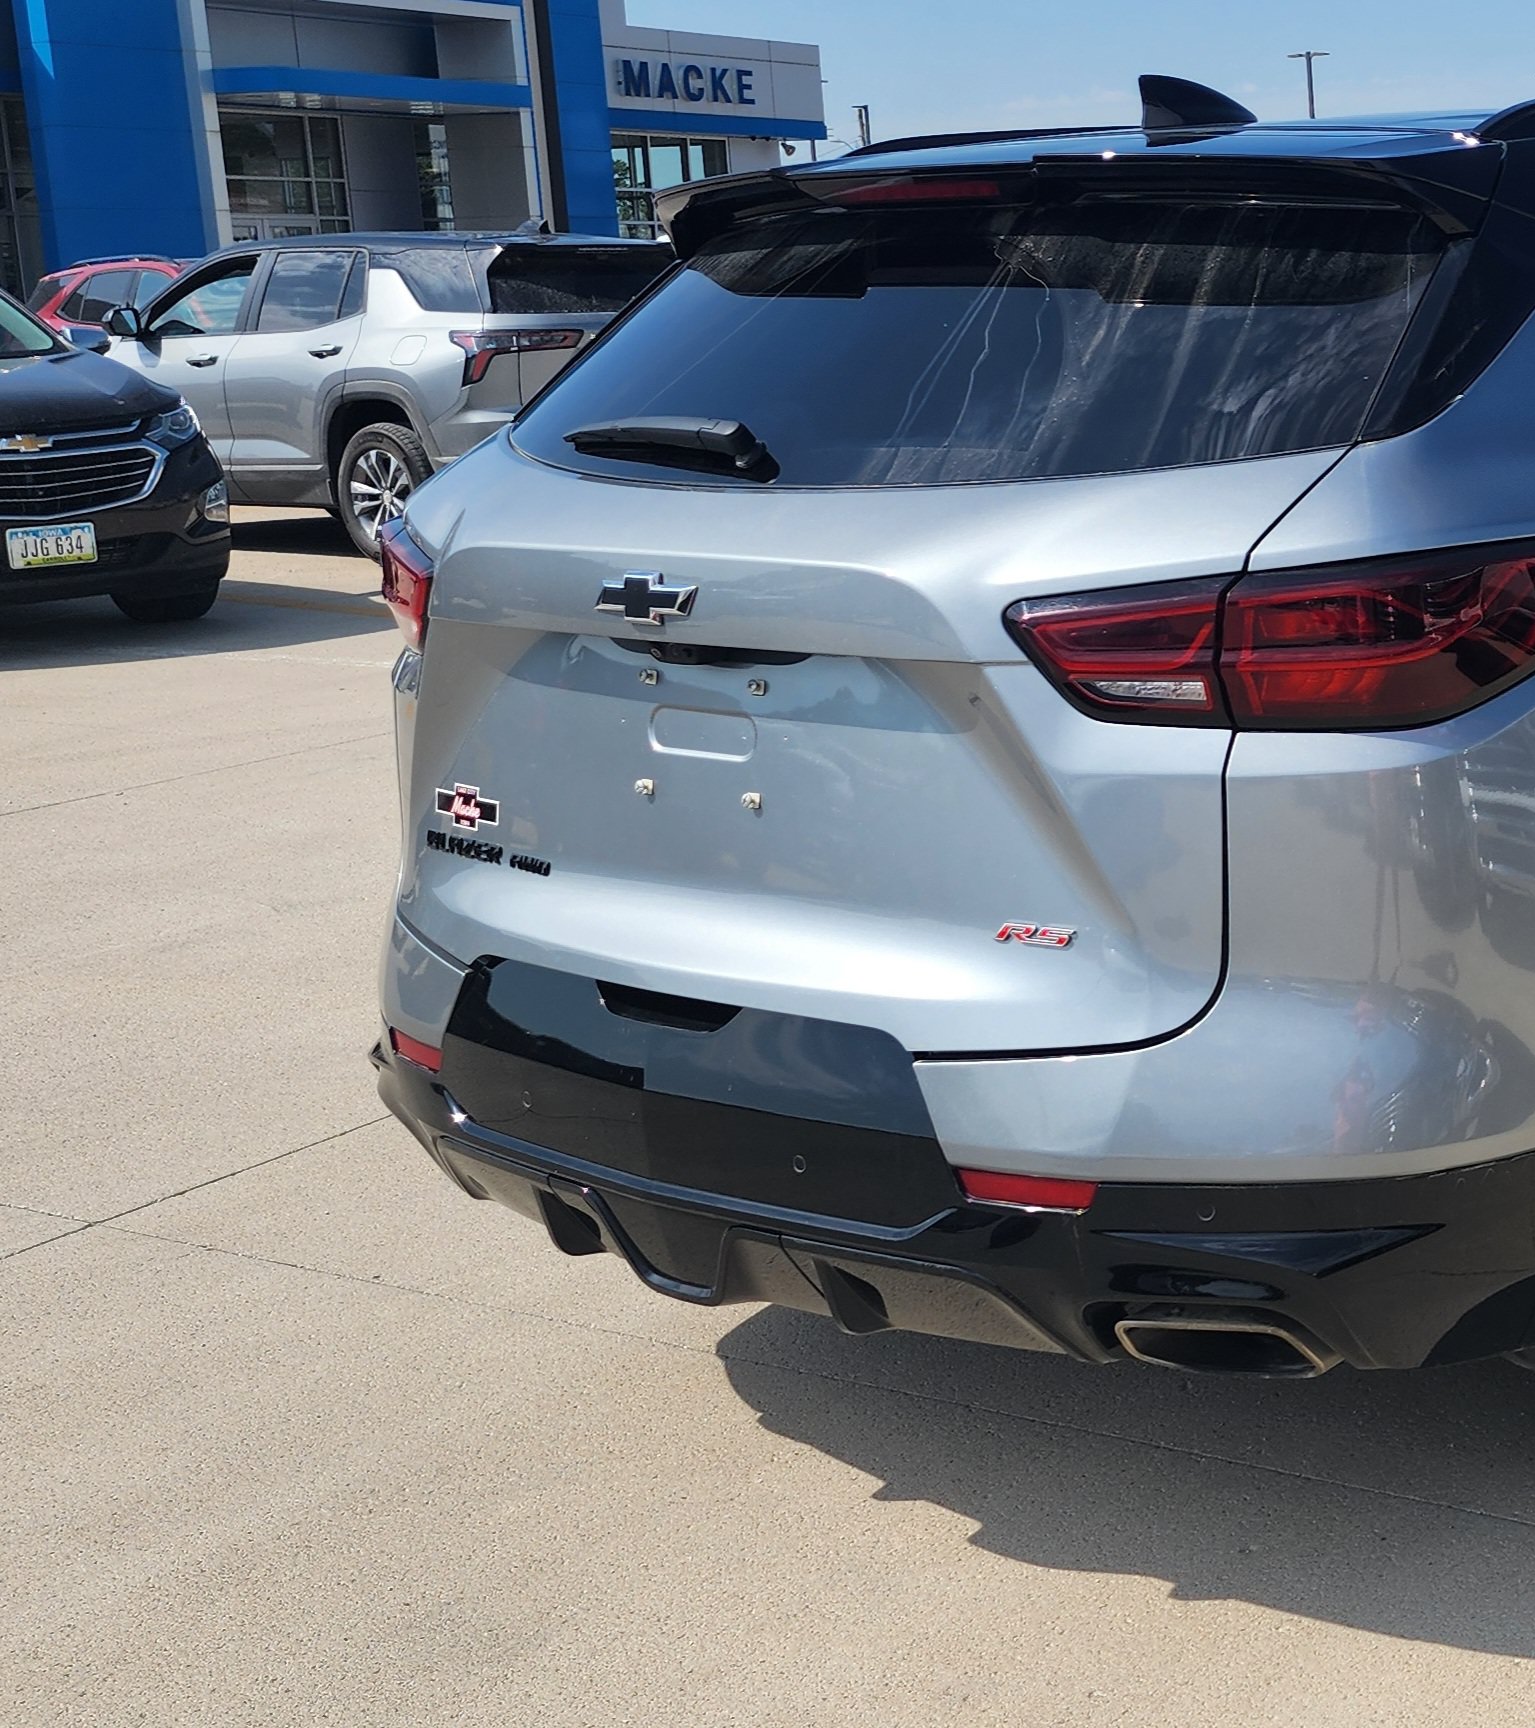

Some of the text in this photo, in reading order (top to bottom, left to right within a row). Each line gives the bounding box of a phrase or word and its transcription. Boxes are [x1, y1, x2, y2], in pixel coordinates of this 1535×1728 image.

[622, 59, 756, 105] MACKE
[39, 529, 63, 537] IOWA
[21, 535, 84, 558] JJG 634
[994, 921, 1077, 947] RS
